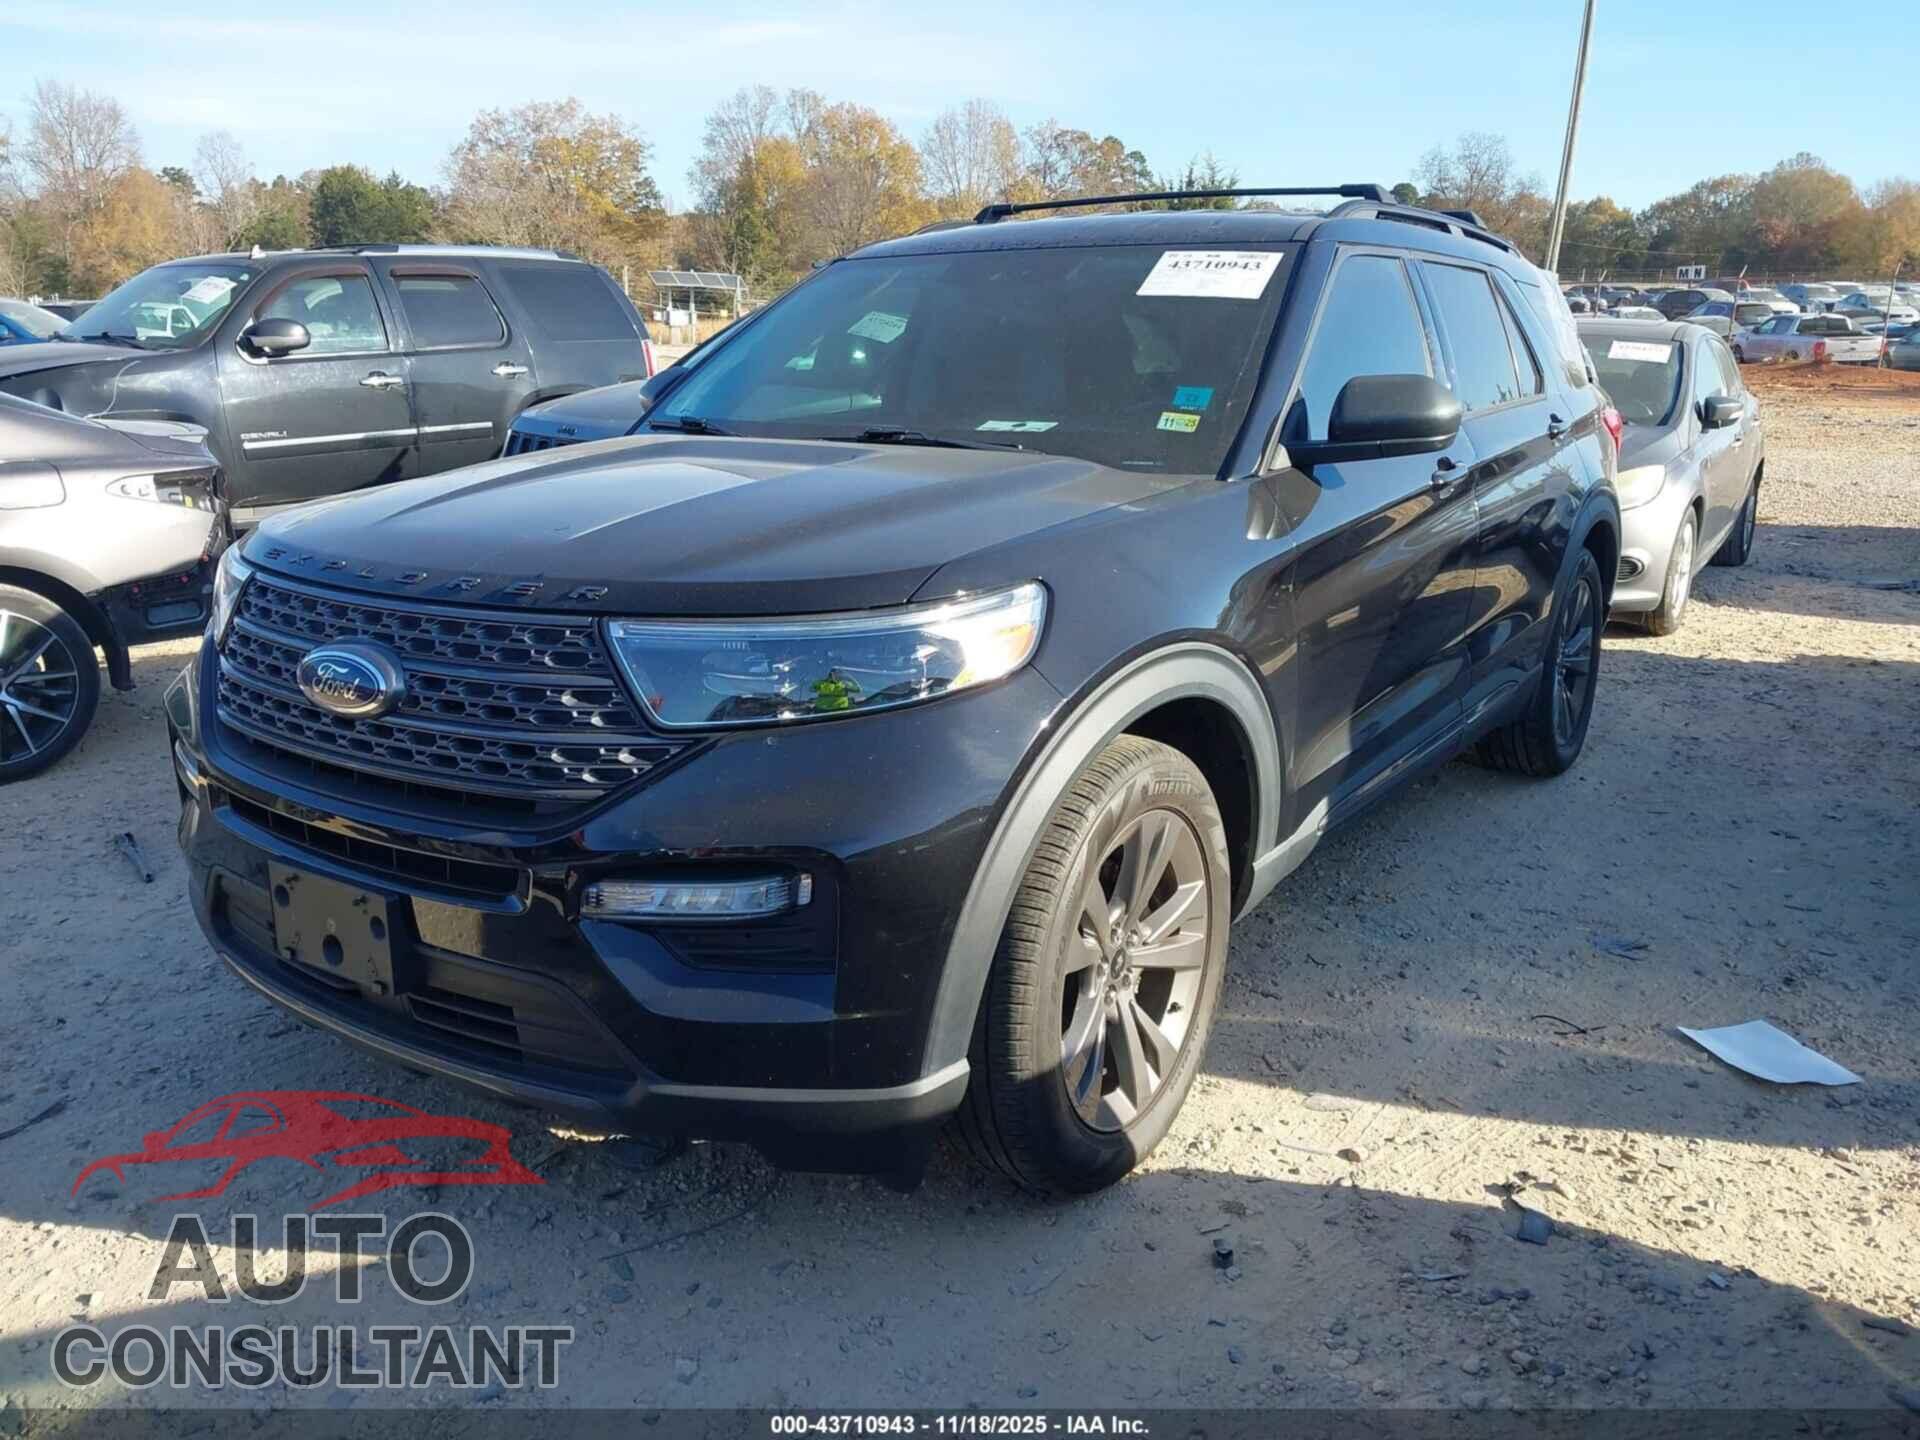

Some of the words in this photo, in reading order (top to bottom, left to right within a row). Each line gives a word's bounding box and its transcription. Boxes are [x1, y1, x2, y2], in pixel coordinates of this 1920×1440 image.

[1168, 259, 1262, 271] 43710943
[240, 430, 288, 440] DENALI
[263, 547, 609, 600] EXPLORER
[311, 660, 361, 702] Ford
